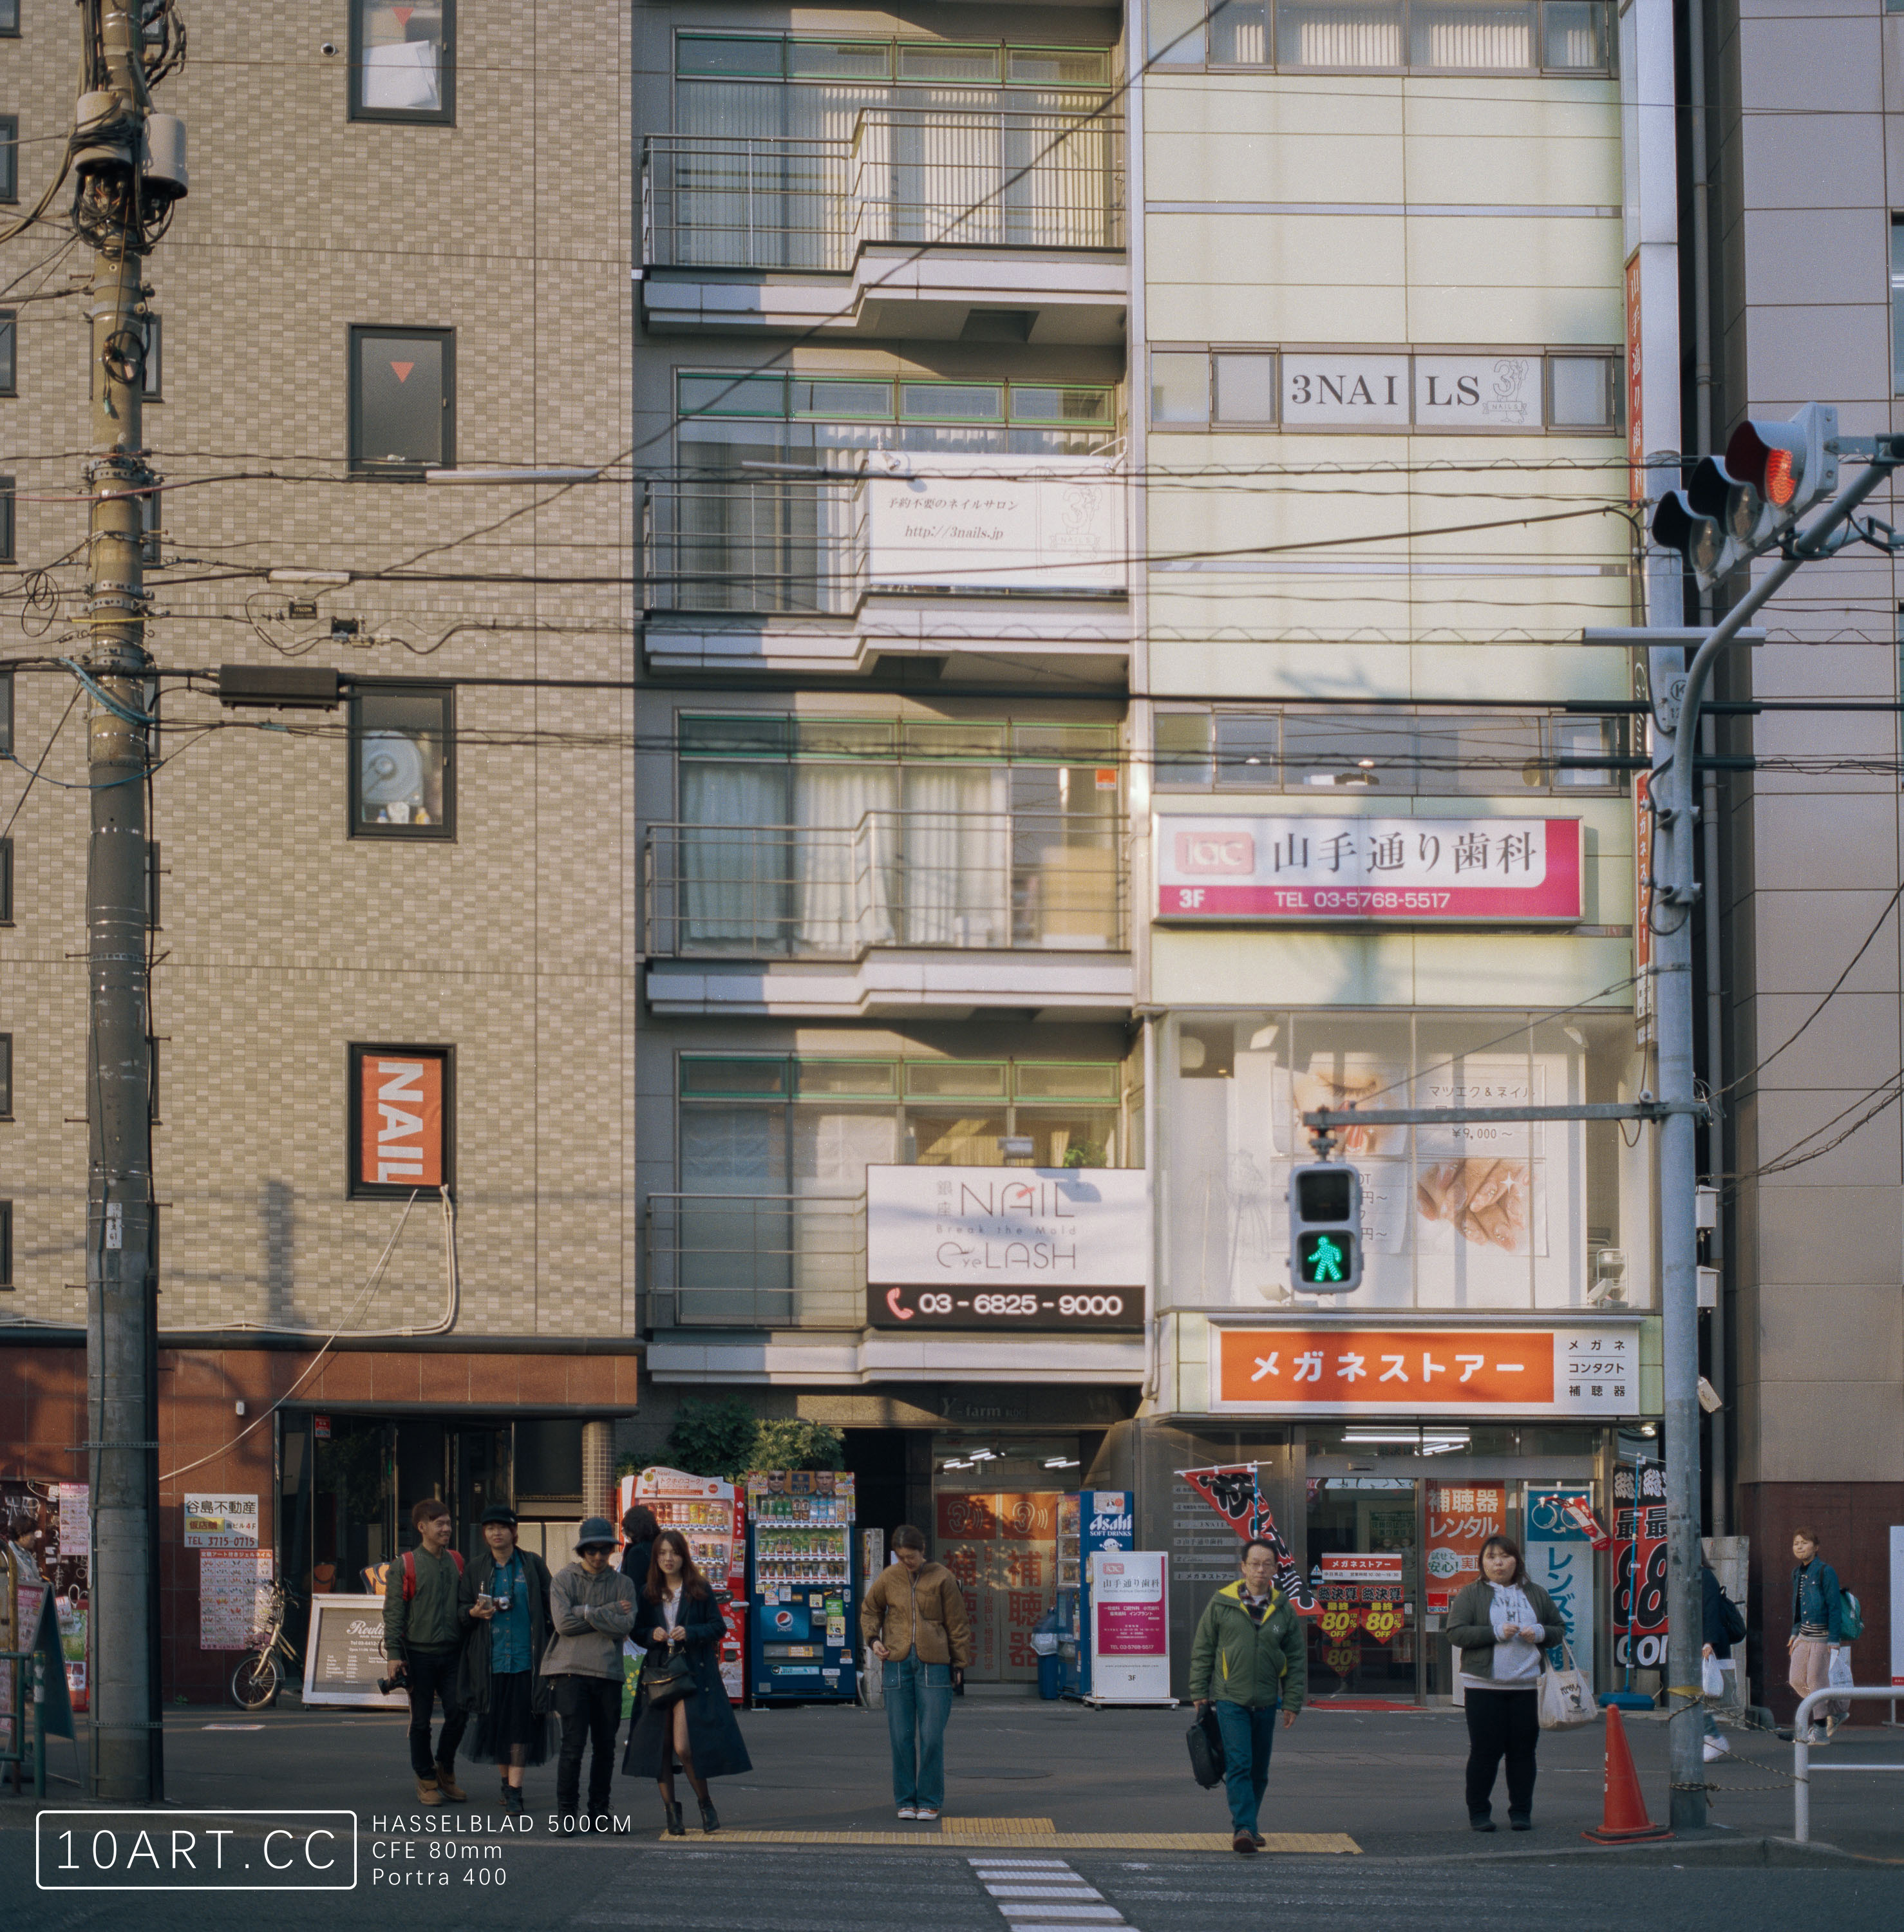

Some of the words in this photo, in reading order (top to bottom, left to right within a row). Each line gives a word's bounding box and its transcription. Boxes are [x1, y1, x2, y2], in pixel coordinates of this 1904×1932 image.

[1630, 269, 1643, 493] 山手通り歯科
[888, 497, 1019, 511] 予約不要のネイルサロン
[905, 525, 1004, 542] http://3nails.jp
[1273, 831, 1538, 874] 山手通り歯科
[1179, 889, 1205, 909] 3F
[1274, 892, 1309, 908] TEL
[1313, 892, 1451, 909] 03-5768-5517
[377, 1061, 424, 1183] NAIL
[961, 1181, 1075, 1217] NAIL
[936, 1225, 985, 1235] Break
[997, 1225, 1023, 1235] the
[1035, 1225, 1077, 1235] Mold
[1568, 1339, 1626, 1351] メガネ
[1250, 1350, 1525, 1383] メガネストアー
[1568, 1362, 1626, 1374] コンタクト
[1568, 1385, 1626, 1397] 補聴器
[186, 1500, 257, 1515] 谷島不動産
[1428, 1488, 1499, 1513] 補聴器
[1089, 1513, 1132, 1531] Asahi
[1430, 1515, 1500, 1539] レンタル
[187, 1536, 203, 1545] TEL
[208, 1536, 255, 1546] 3715-0715
[1431, 1551, 1455, 1560] 試せて
[1428, 1560, 1459, 1573] 安心!
[1103, 1578, 1160, 1588] 山手通り歯科
[1318, 1586, 1358, 1602] 総決算
[1362, 1586, 1402, 1602] 総決算
[1007, 1550, 1043, 1668] 補聴器
[1327, 1602, 1349, 1611] 最終
[1371, 1602, 1393, 1611] 最終
